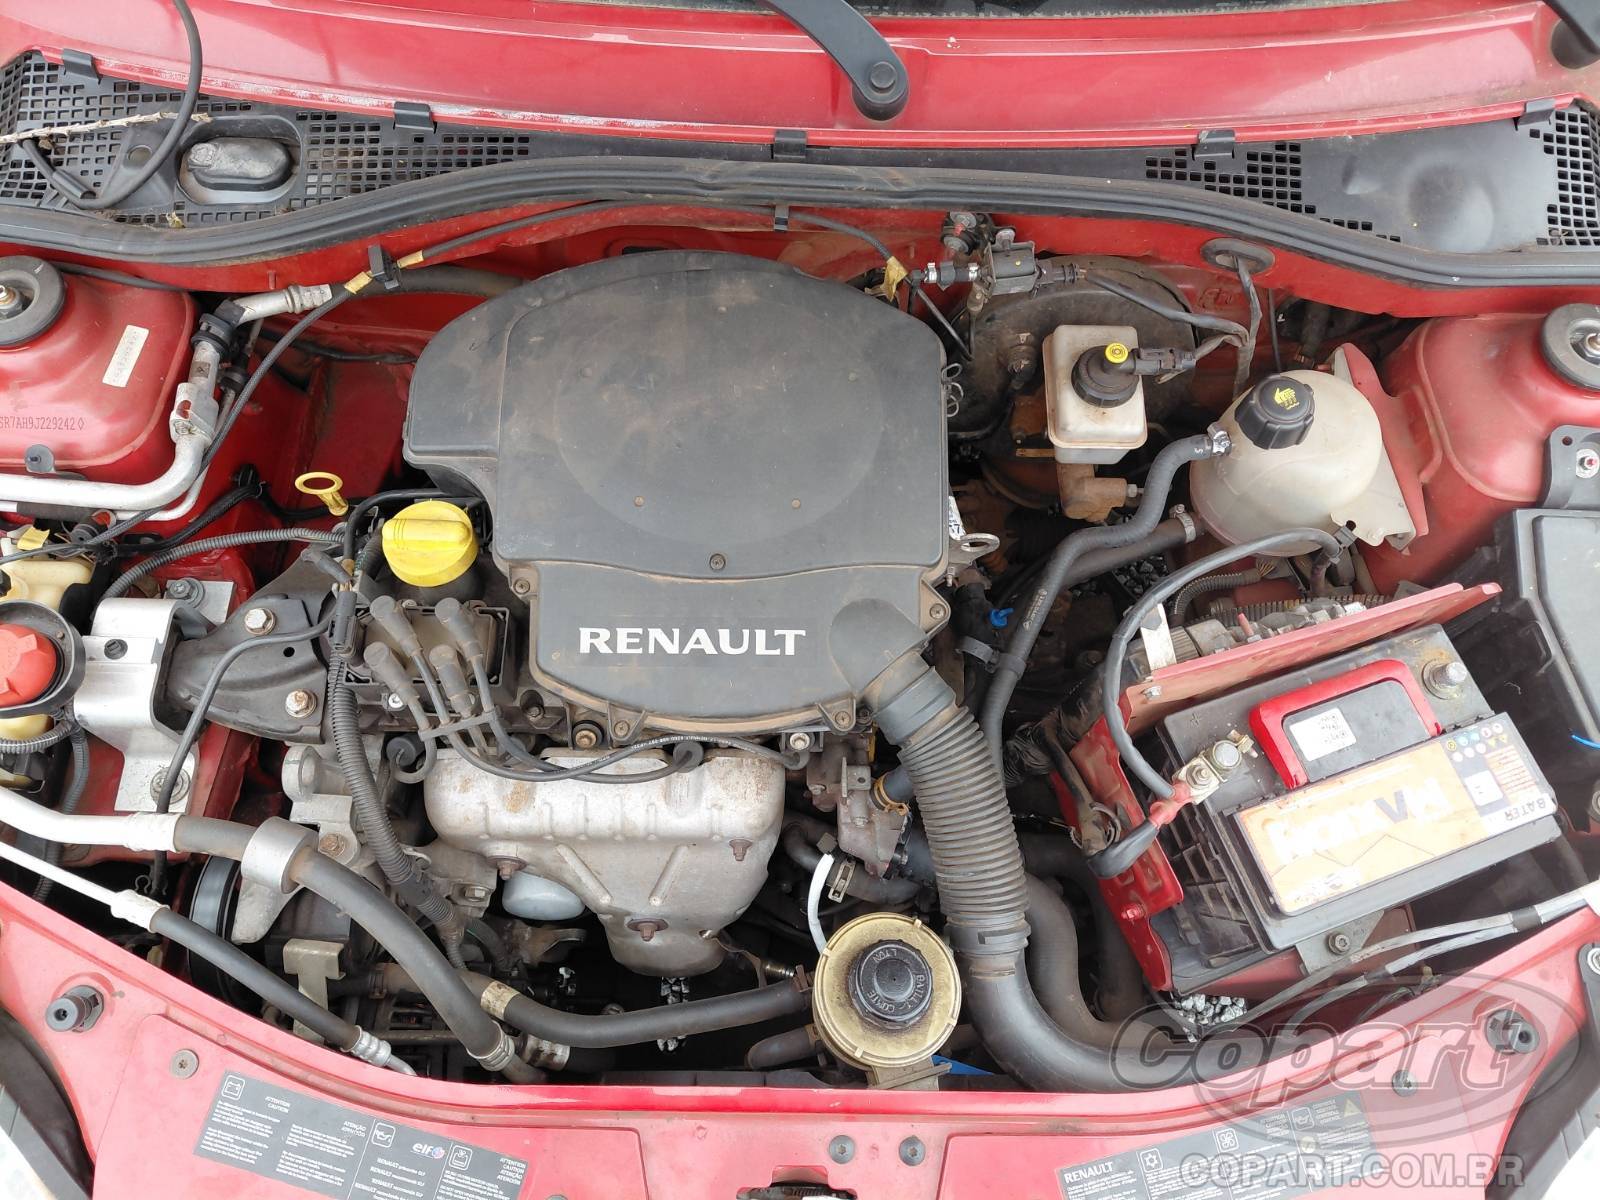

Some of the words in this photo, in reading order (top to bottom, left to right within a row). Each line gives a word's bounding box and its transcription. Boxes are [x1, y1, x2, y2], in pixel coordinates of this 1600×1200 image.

[578, 627, 807, 656] RENAULT
[412, 1142, 434, 1155] elf
[1064, 1162, 1113, 1183] RENAULT
